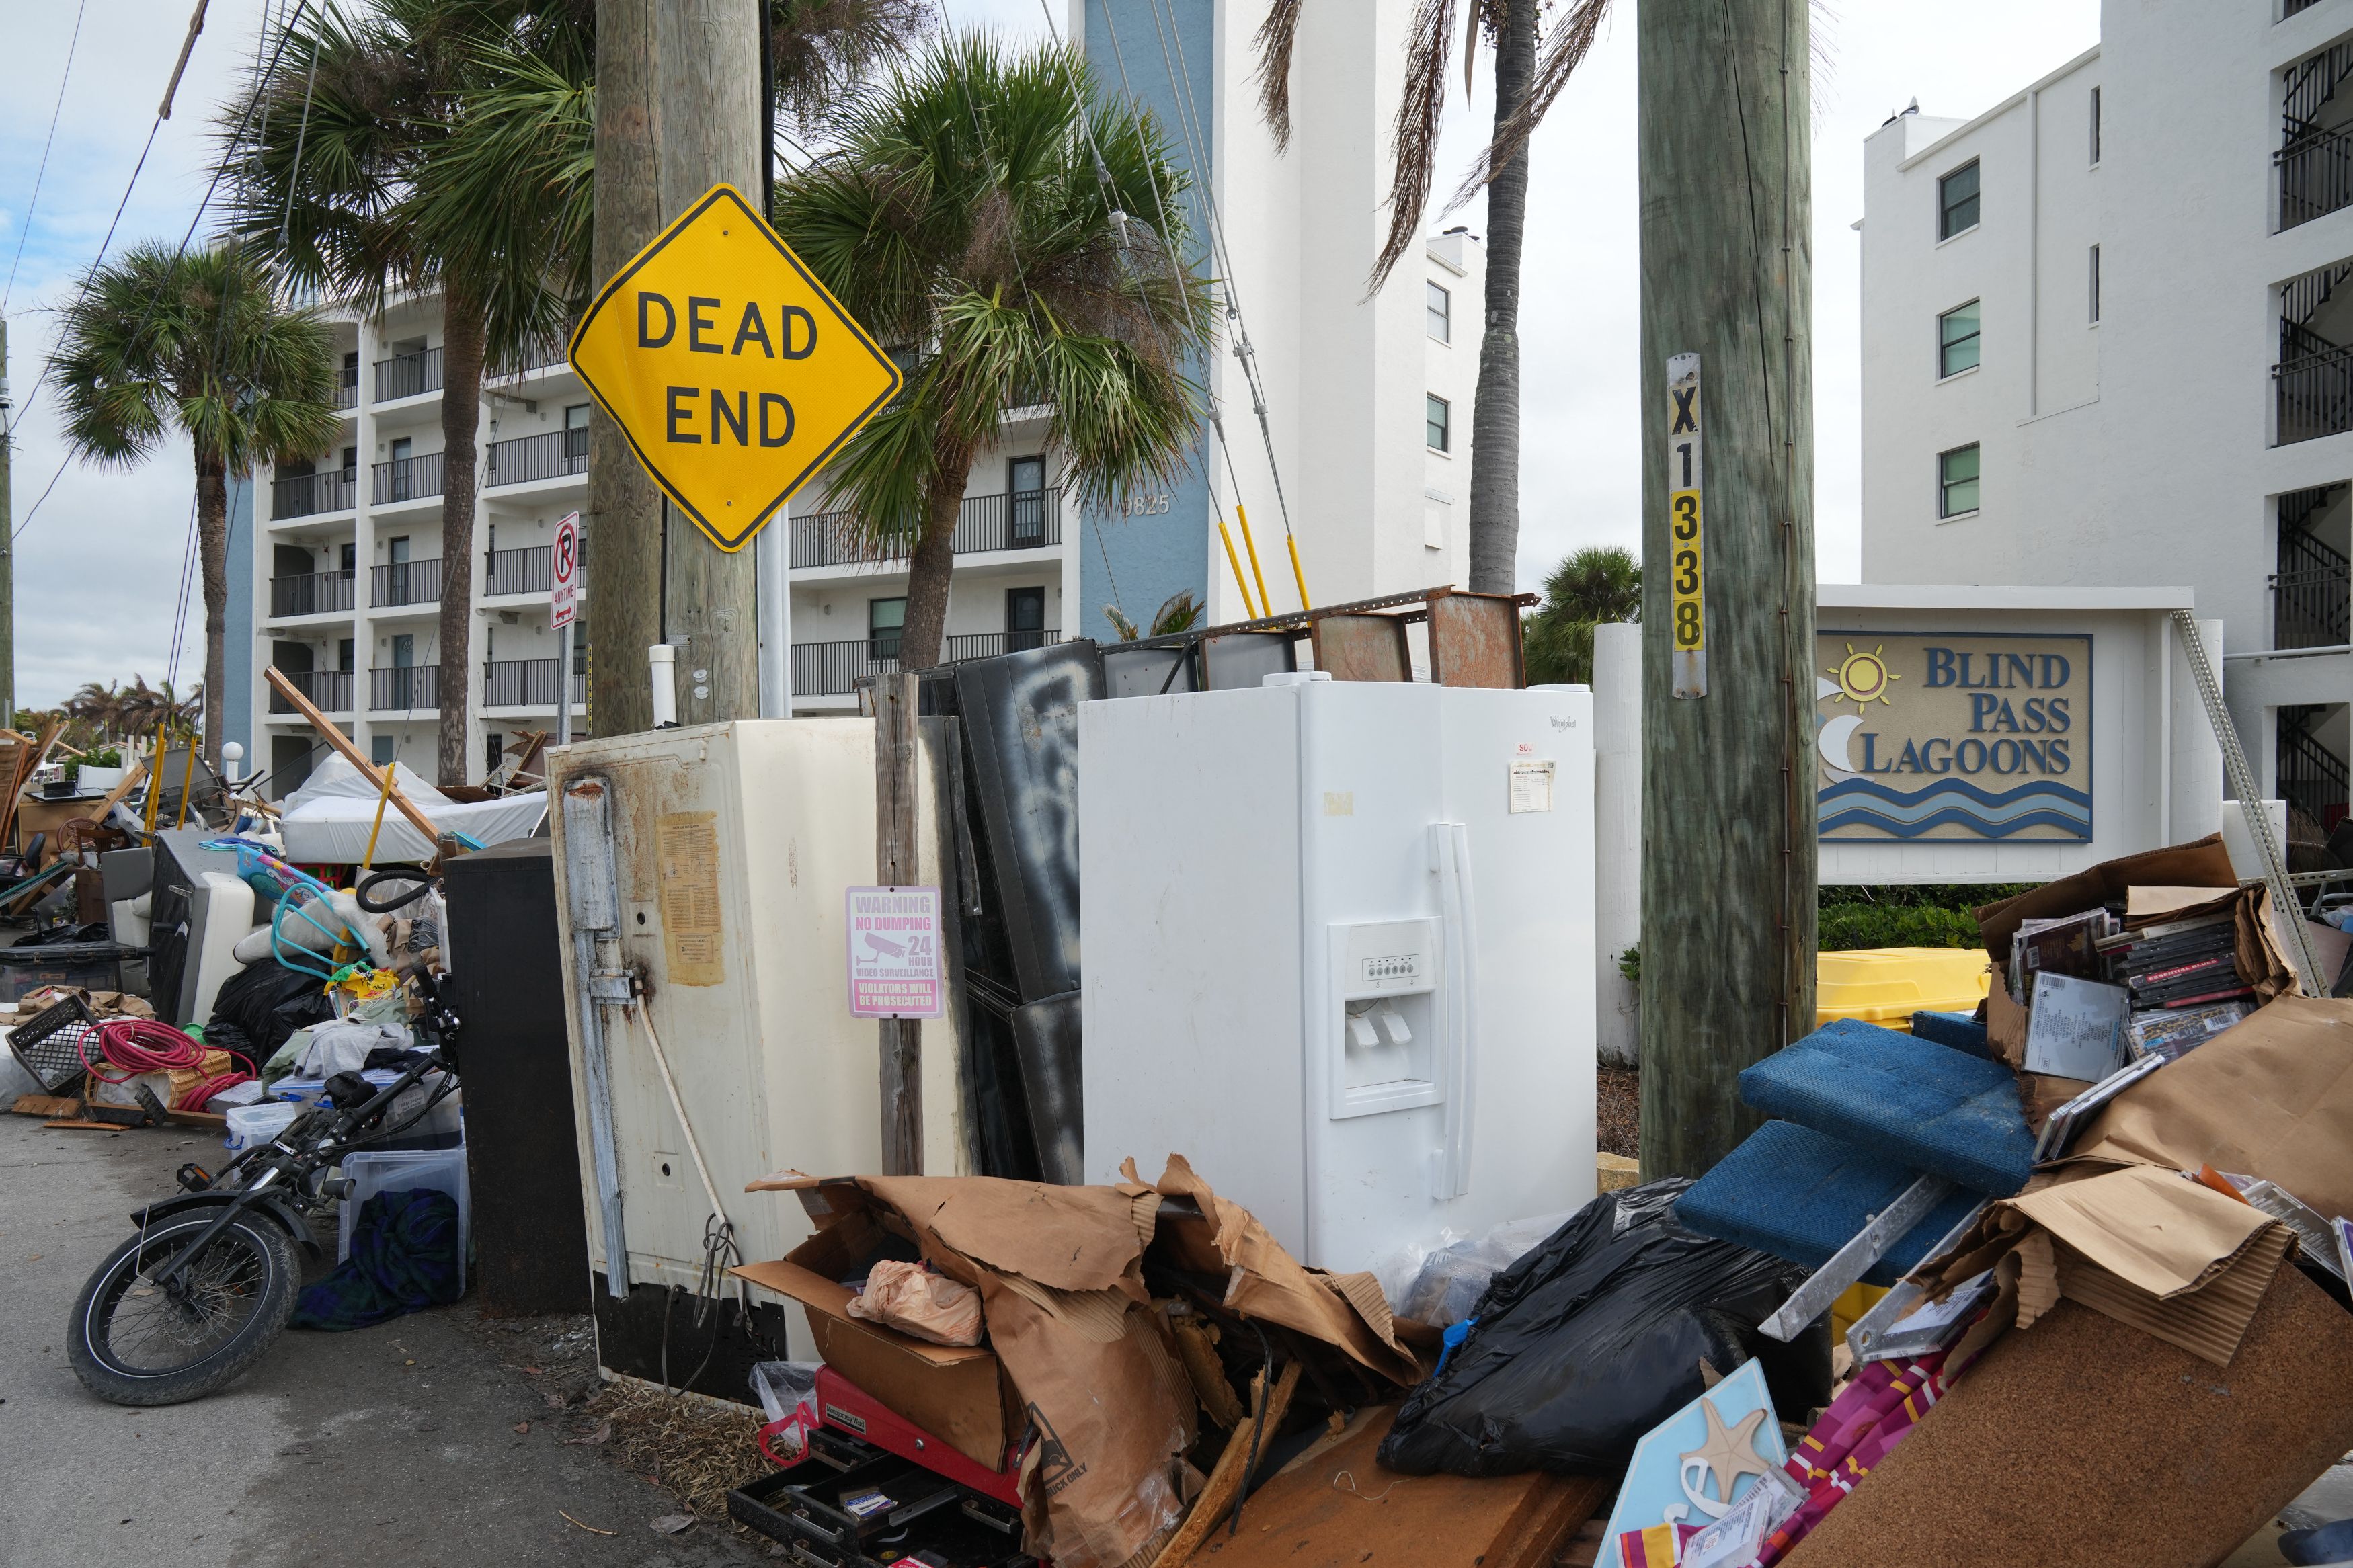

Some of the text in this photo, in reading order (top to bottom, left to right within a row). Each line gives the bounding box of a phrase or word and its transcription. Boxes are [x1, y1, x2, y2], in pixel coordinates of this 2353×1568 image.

[638, 292, 817, 360] DEAD
[667, 386, 795, 447] END
[555, 585, 574, 605] ANYTIME
[1923, 647, 2071, 689] BLIND
[1968, 693, 2071, 733] PASS
[1860, 733, 2071, 774] LAGOONS
[856, 897, 930, 913] WARNING
[856, 917, 931, 930] NO DUMPING
[908, 936, 932, 955] 24
[908, 957, 933, 966] HOUR
[2149, 960, 2217, 981] ESSENTIAL BLUES
[856, 968, 934, 977] VIDEO SURVEILLANCE
[859, 983, 931, 993] VIOLATORS WILL
[859, 996, 932, 1006] BE PROSECUTED
[827, 1405, 865, 1428] Montgomery Ward
[1045, 1462, 1088, 1499] RUCK ONLY
